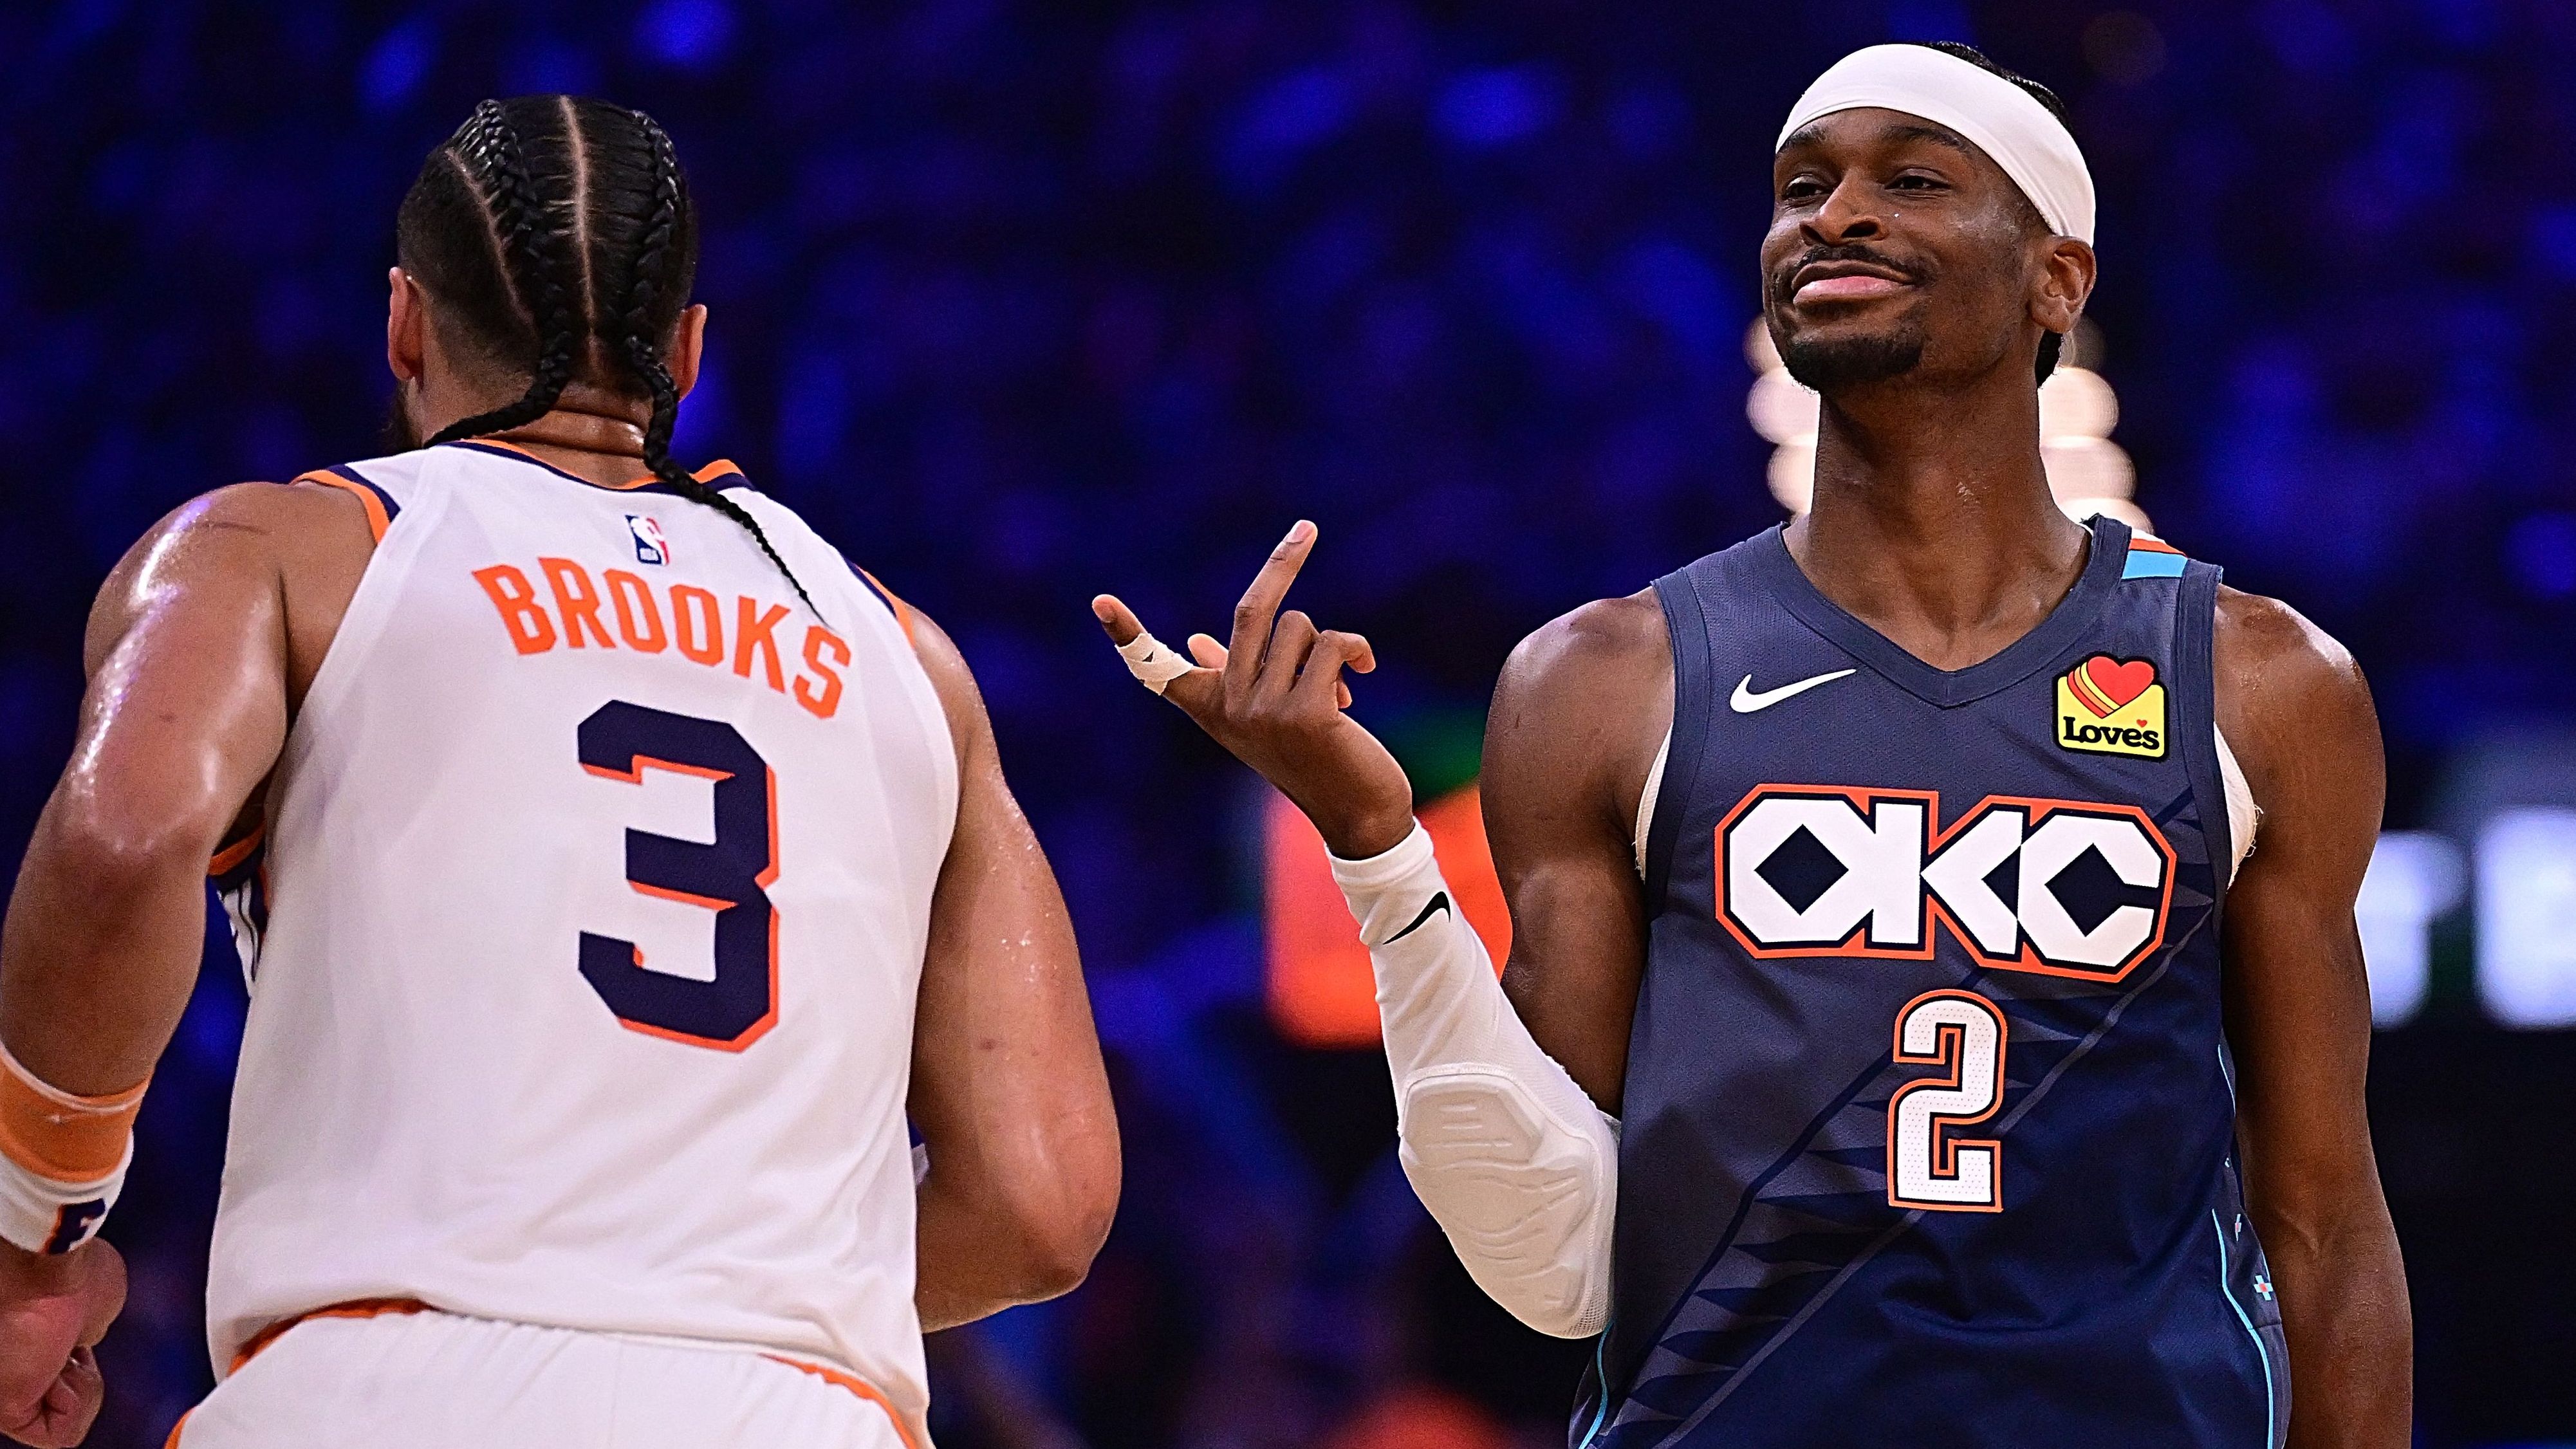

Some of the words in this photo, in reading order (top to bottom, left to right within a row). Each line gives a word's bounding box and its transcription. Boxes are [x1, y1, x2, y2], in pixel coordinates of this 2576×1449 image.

[472, 557, 851, 719] BROOKS
[578, 699, 779, 1053] 3
[1715, 784, 2176, 983] OKC
[1887, 989, 2008, 1212] 2
